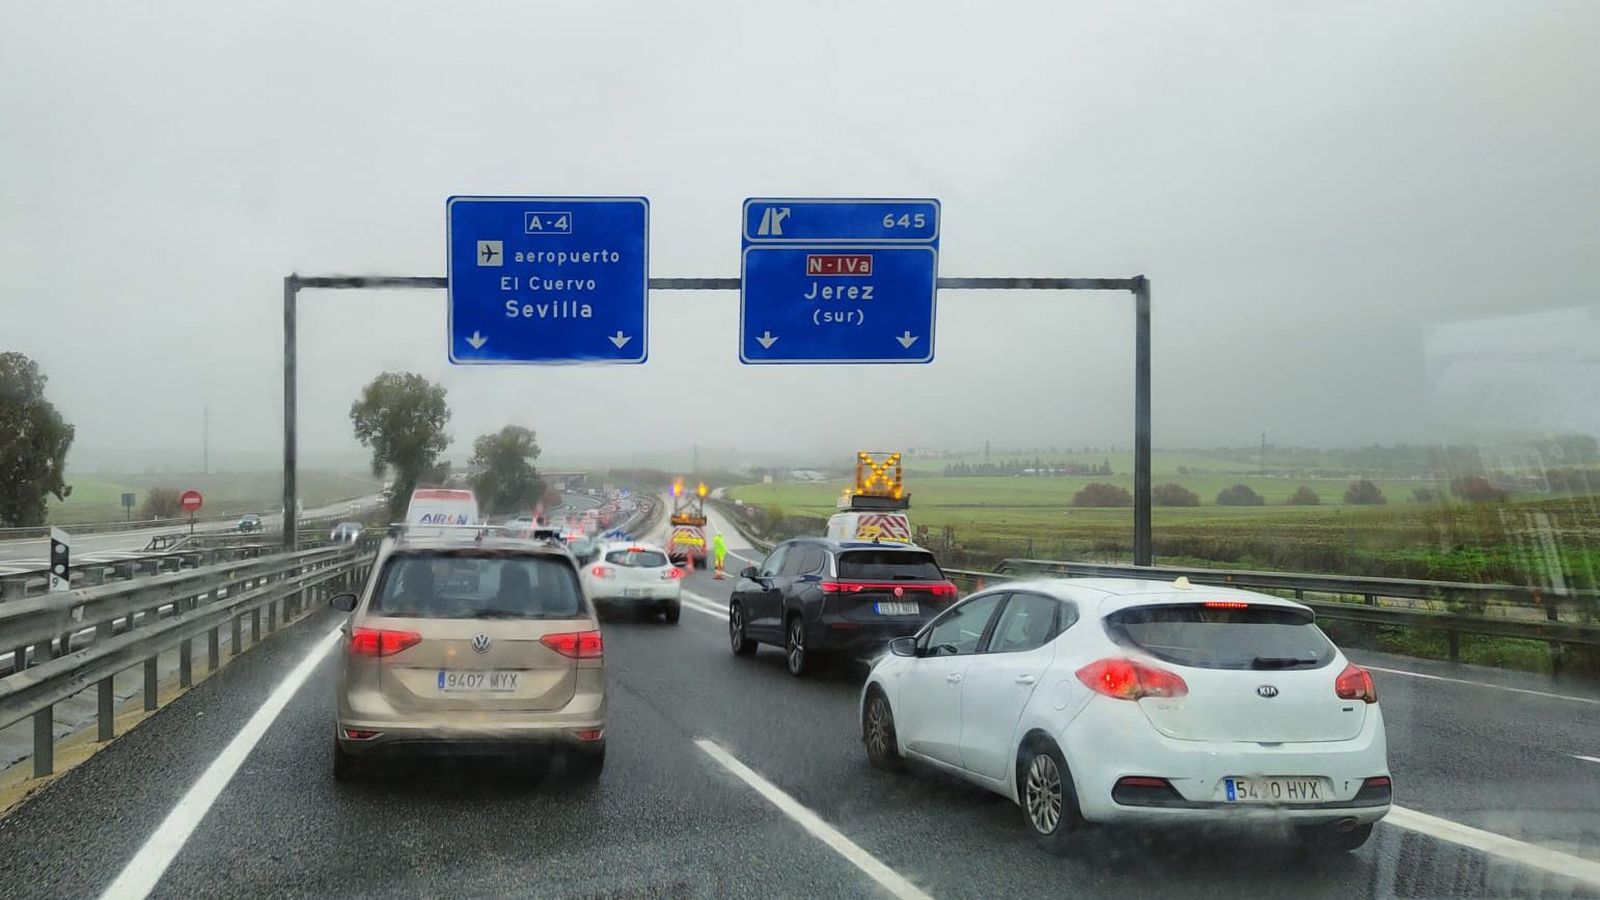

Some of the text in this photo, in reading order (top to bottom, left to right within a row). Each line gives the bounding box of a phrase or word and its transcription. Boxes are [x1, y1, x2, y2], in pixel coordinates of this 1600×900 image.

[529, 215, 569, 231] A-4
[882, 213, 926, 228] 645
[514, 249, 620, 267] aeropuerto
[809, 258, 870, 273] N-IVa
[500, 276, 596, 291] El Cuervo
[803, 282, 875, 300] Jerez
[505, 299, 592, 318] Sevilla
[813, 308, 865, 326] (sur)
[448, 673, 517, 688] 9407 MYX
[1259, 686, 1277, 697] KIA
[1287, 781, 1320, 799] HVX
